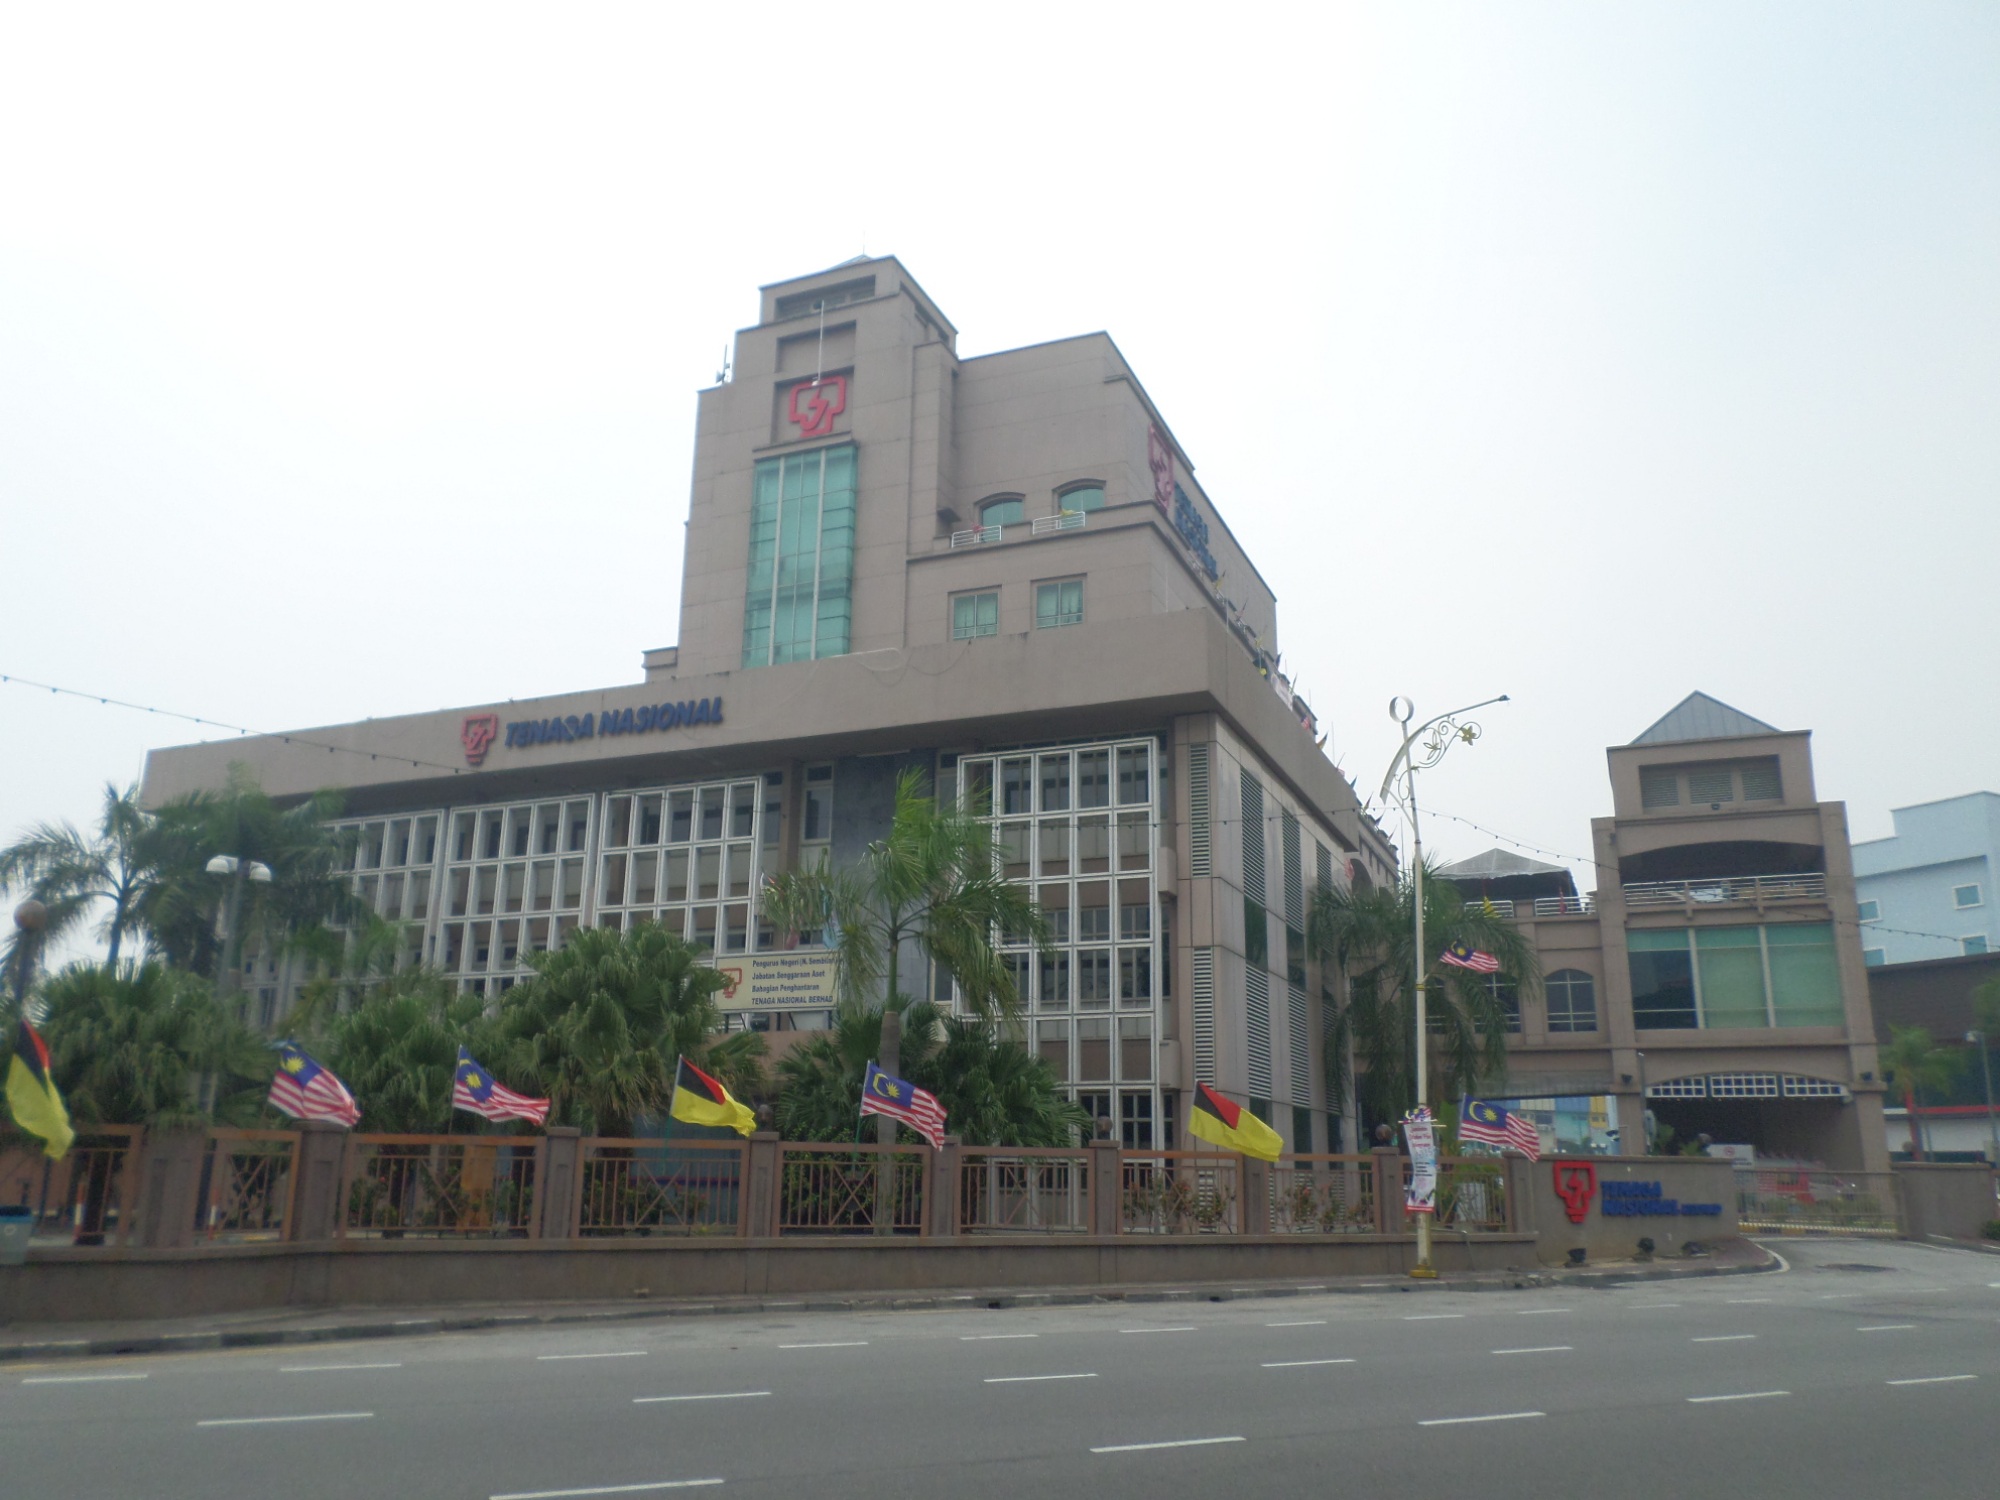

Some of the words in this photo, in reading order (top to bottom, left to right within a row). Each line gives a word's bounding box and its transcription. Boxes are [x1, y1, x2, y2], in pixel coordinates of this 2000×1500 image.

[599, 696, 724, 735] NASIONAL
[752, 960, 779, 968] Pengurus
[780, 959, 799, 967] Negeri
[777, 972, 811, 980] Senggaraan
[752, 985, 779, 993] Bahagian
[780, 984, 820, 992] Penghantaran
[1601, 1181, 1662, 1198] TENAGA
[1602, 1199, 1680, 1216] NASIONAL
